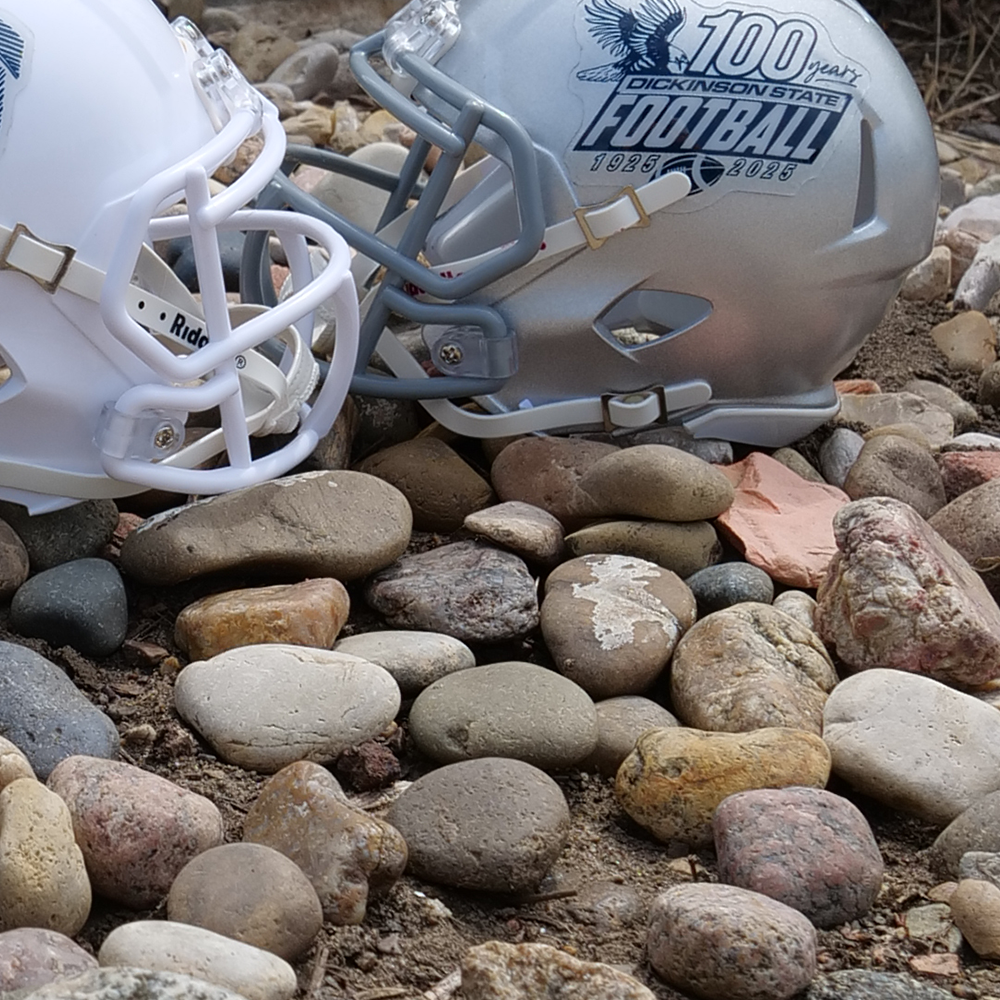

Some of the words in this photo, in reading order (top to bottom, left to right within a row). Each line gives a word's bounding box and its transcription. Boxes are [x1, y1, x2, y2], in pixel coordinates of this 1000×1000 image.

[687, 8, 818, 82] 100
[806, 60, 863, 86] years
[626, 77, 771, 98] DICKINSON
[768, 86, 840, 107] STATE
[581, 93, 832, 160] FOOTBALL
[590, 152, 661, 173] 1925
[726, 158, 798, 182] 2025
